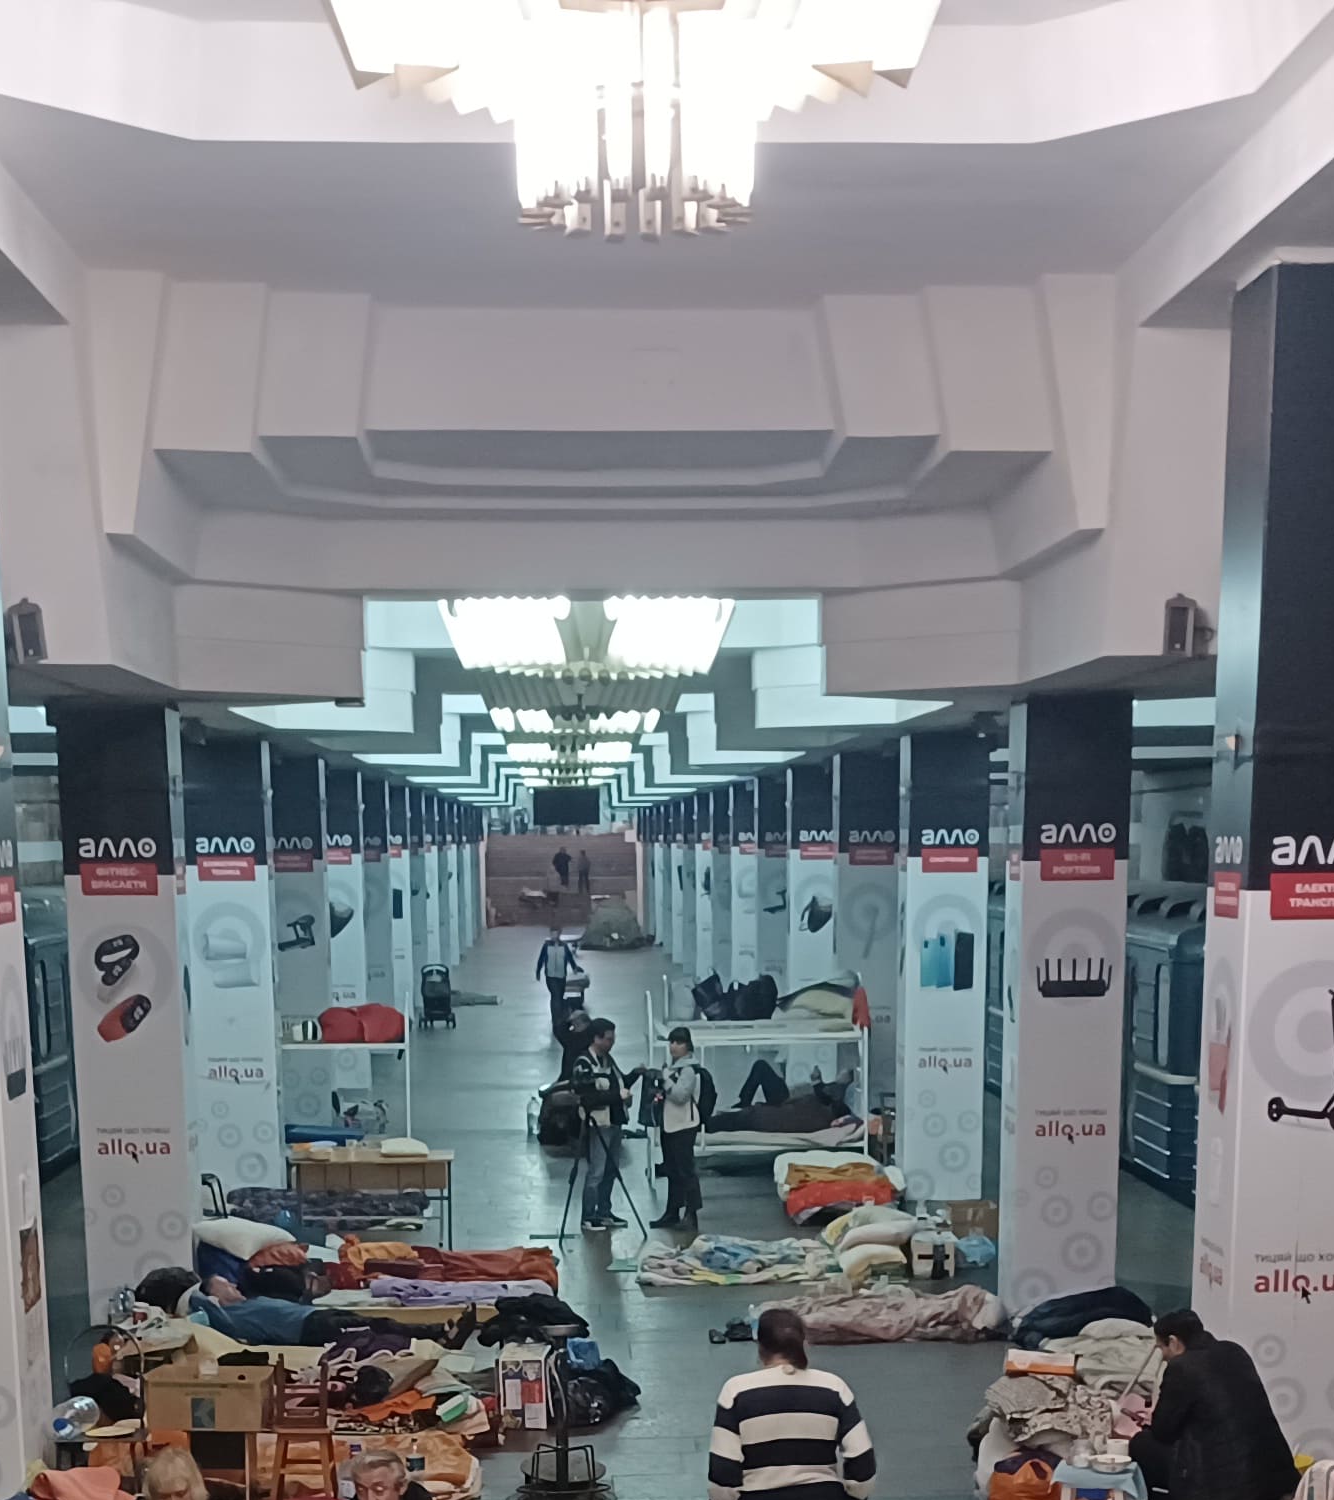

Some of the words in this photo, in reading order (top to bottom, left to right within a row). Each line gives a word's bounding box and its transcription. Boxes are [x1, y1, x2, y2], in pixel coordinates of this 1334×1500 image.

[921, 828, 980, 845] алло
[1040, 822, 1116, 844] алло
[78, 837, 157, 858] алло
[195, 836, 255, 854] алло
[1035, 1120, 1107, 1137] allo.ua
[97, 1138, 171, 1155] allo.ua
